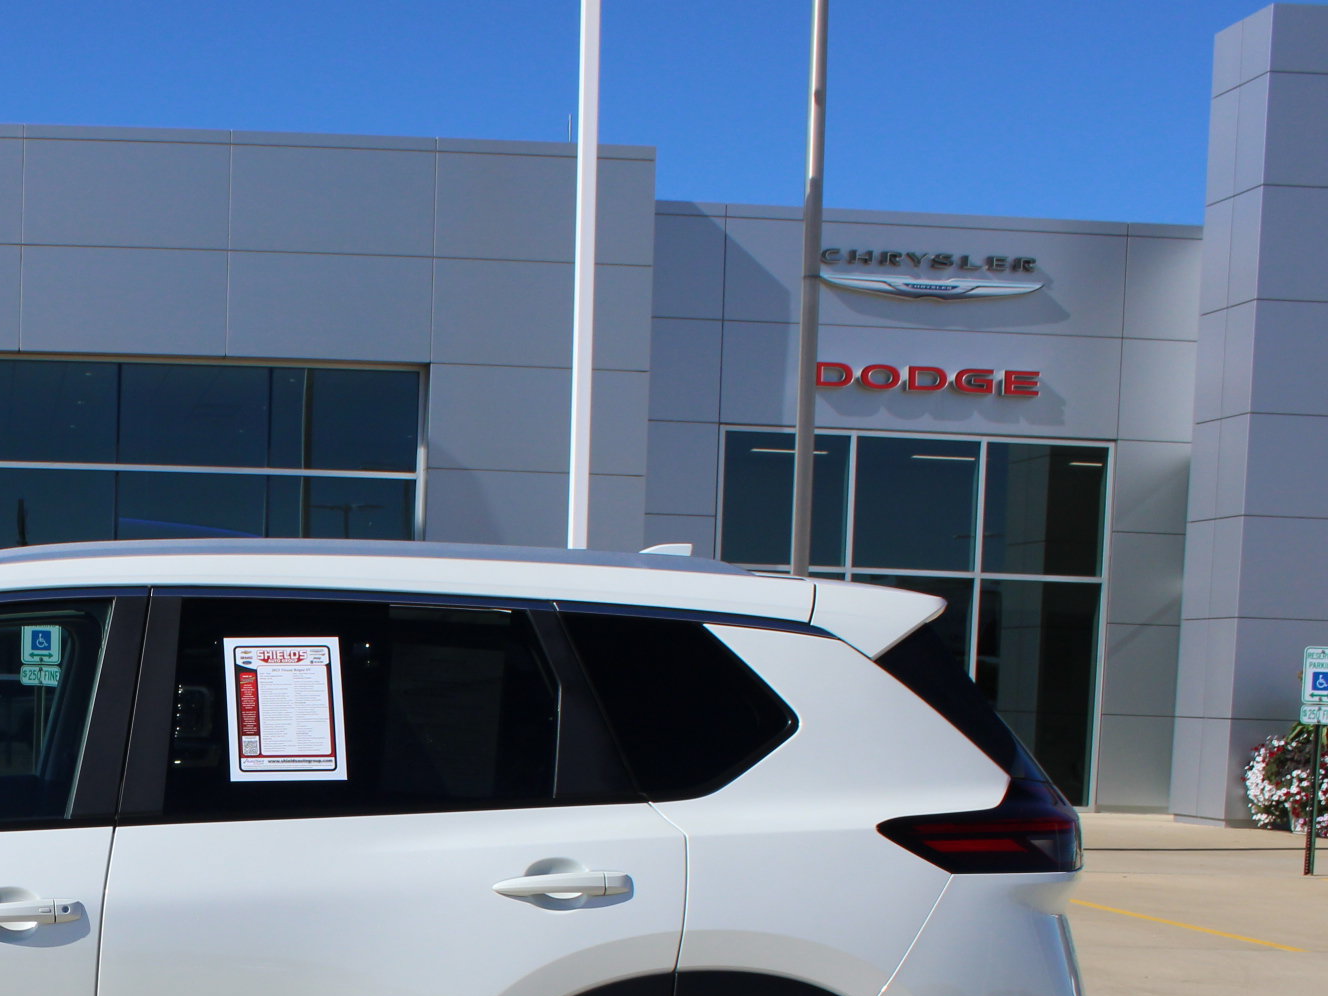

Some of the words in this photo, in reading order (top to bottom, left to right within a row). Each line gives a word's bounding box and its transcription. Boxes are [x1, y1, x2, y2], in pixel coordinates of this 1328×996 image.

[820, 247, 1038, 273] CHRYSLER
[816, 361, 1041, 397] DODGE
[256, 649, 308, 660] SHIELDS
